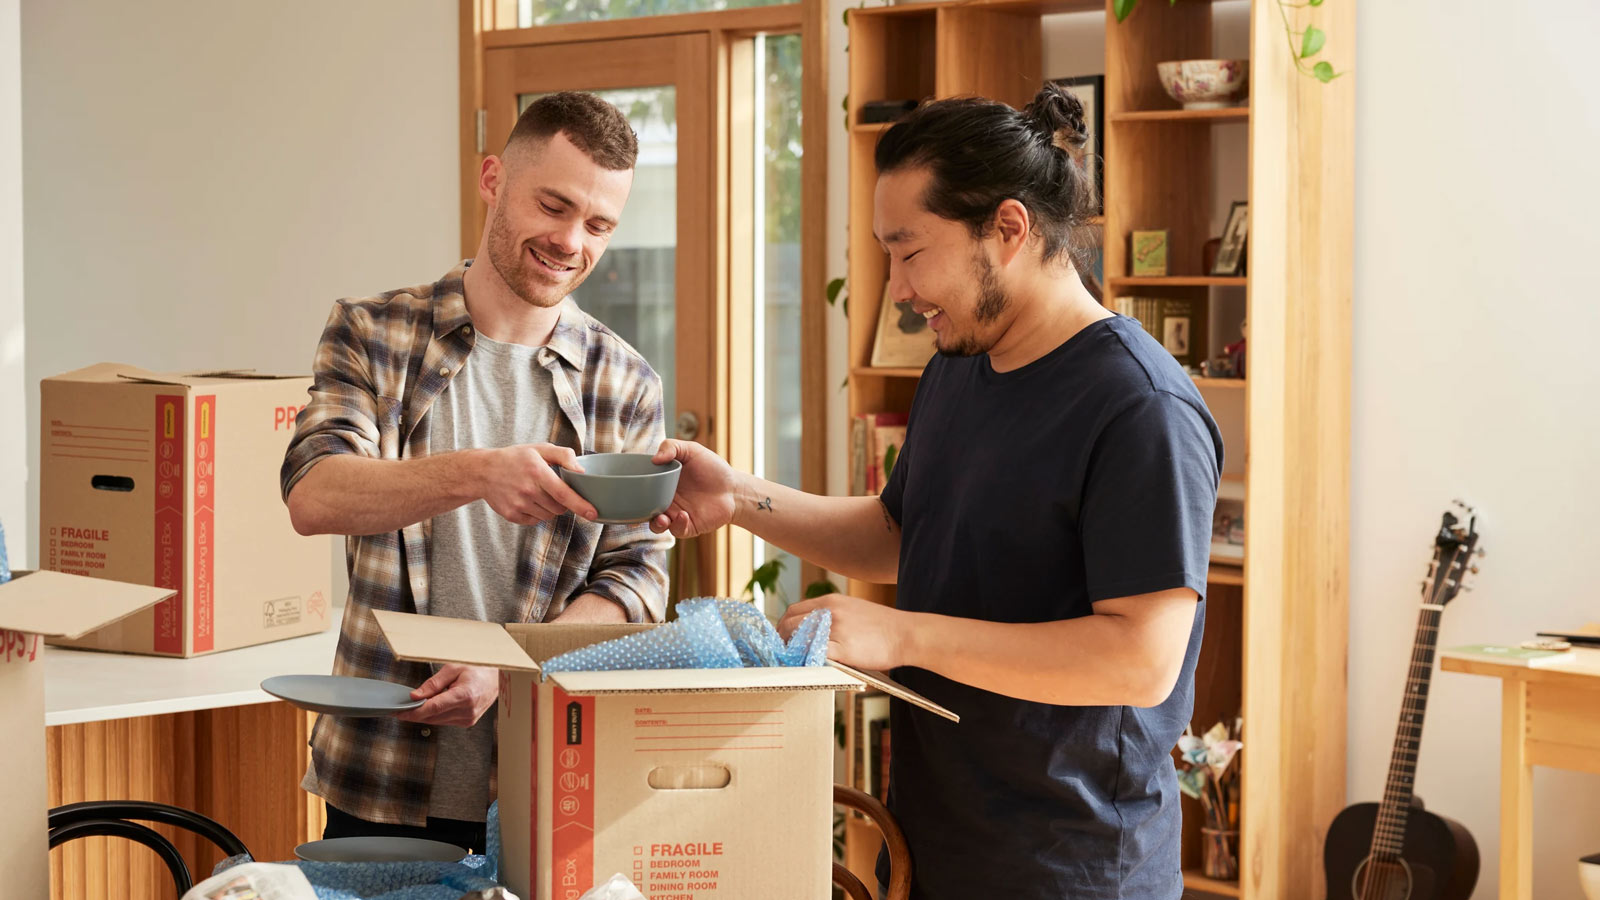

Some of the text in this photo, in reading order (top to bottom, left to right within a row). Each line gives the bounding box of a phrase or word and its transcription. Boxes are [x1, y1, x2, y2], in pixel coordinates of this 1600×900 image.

[275, 404, 306, 431] PP
[61, 527, 109, 541] FRAGILE
[198, 521, 206, 544] Box
[61, 540, 94, 549] BEDROOM
[61, 550, 107, 560] FAMILY ROOM
[61, 559, 105, 569] DINING ROOM
[198, 546, 208, 588] Moving
[650, 842, 723, 857] FRAGILE
[649, 860, 701, 869] BEDROOM
[562, 858, 577, 887] Box
[649, 870, 719, 880] FAMILY ROOM
[649, 882, 717, 892] DINING ROOM
